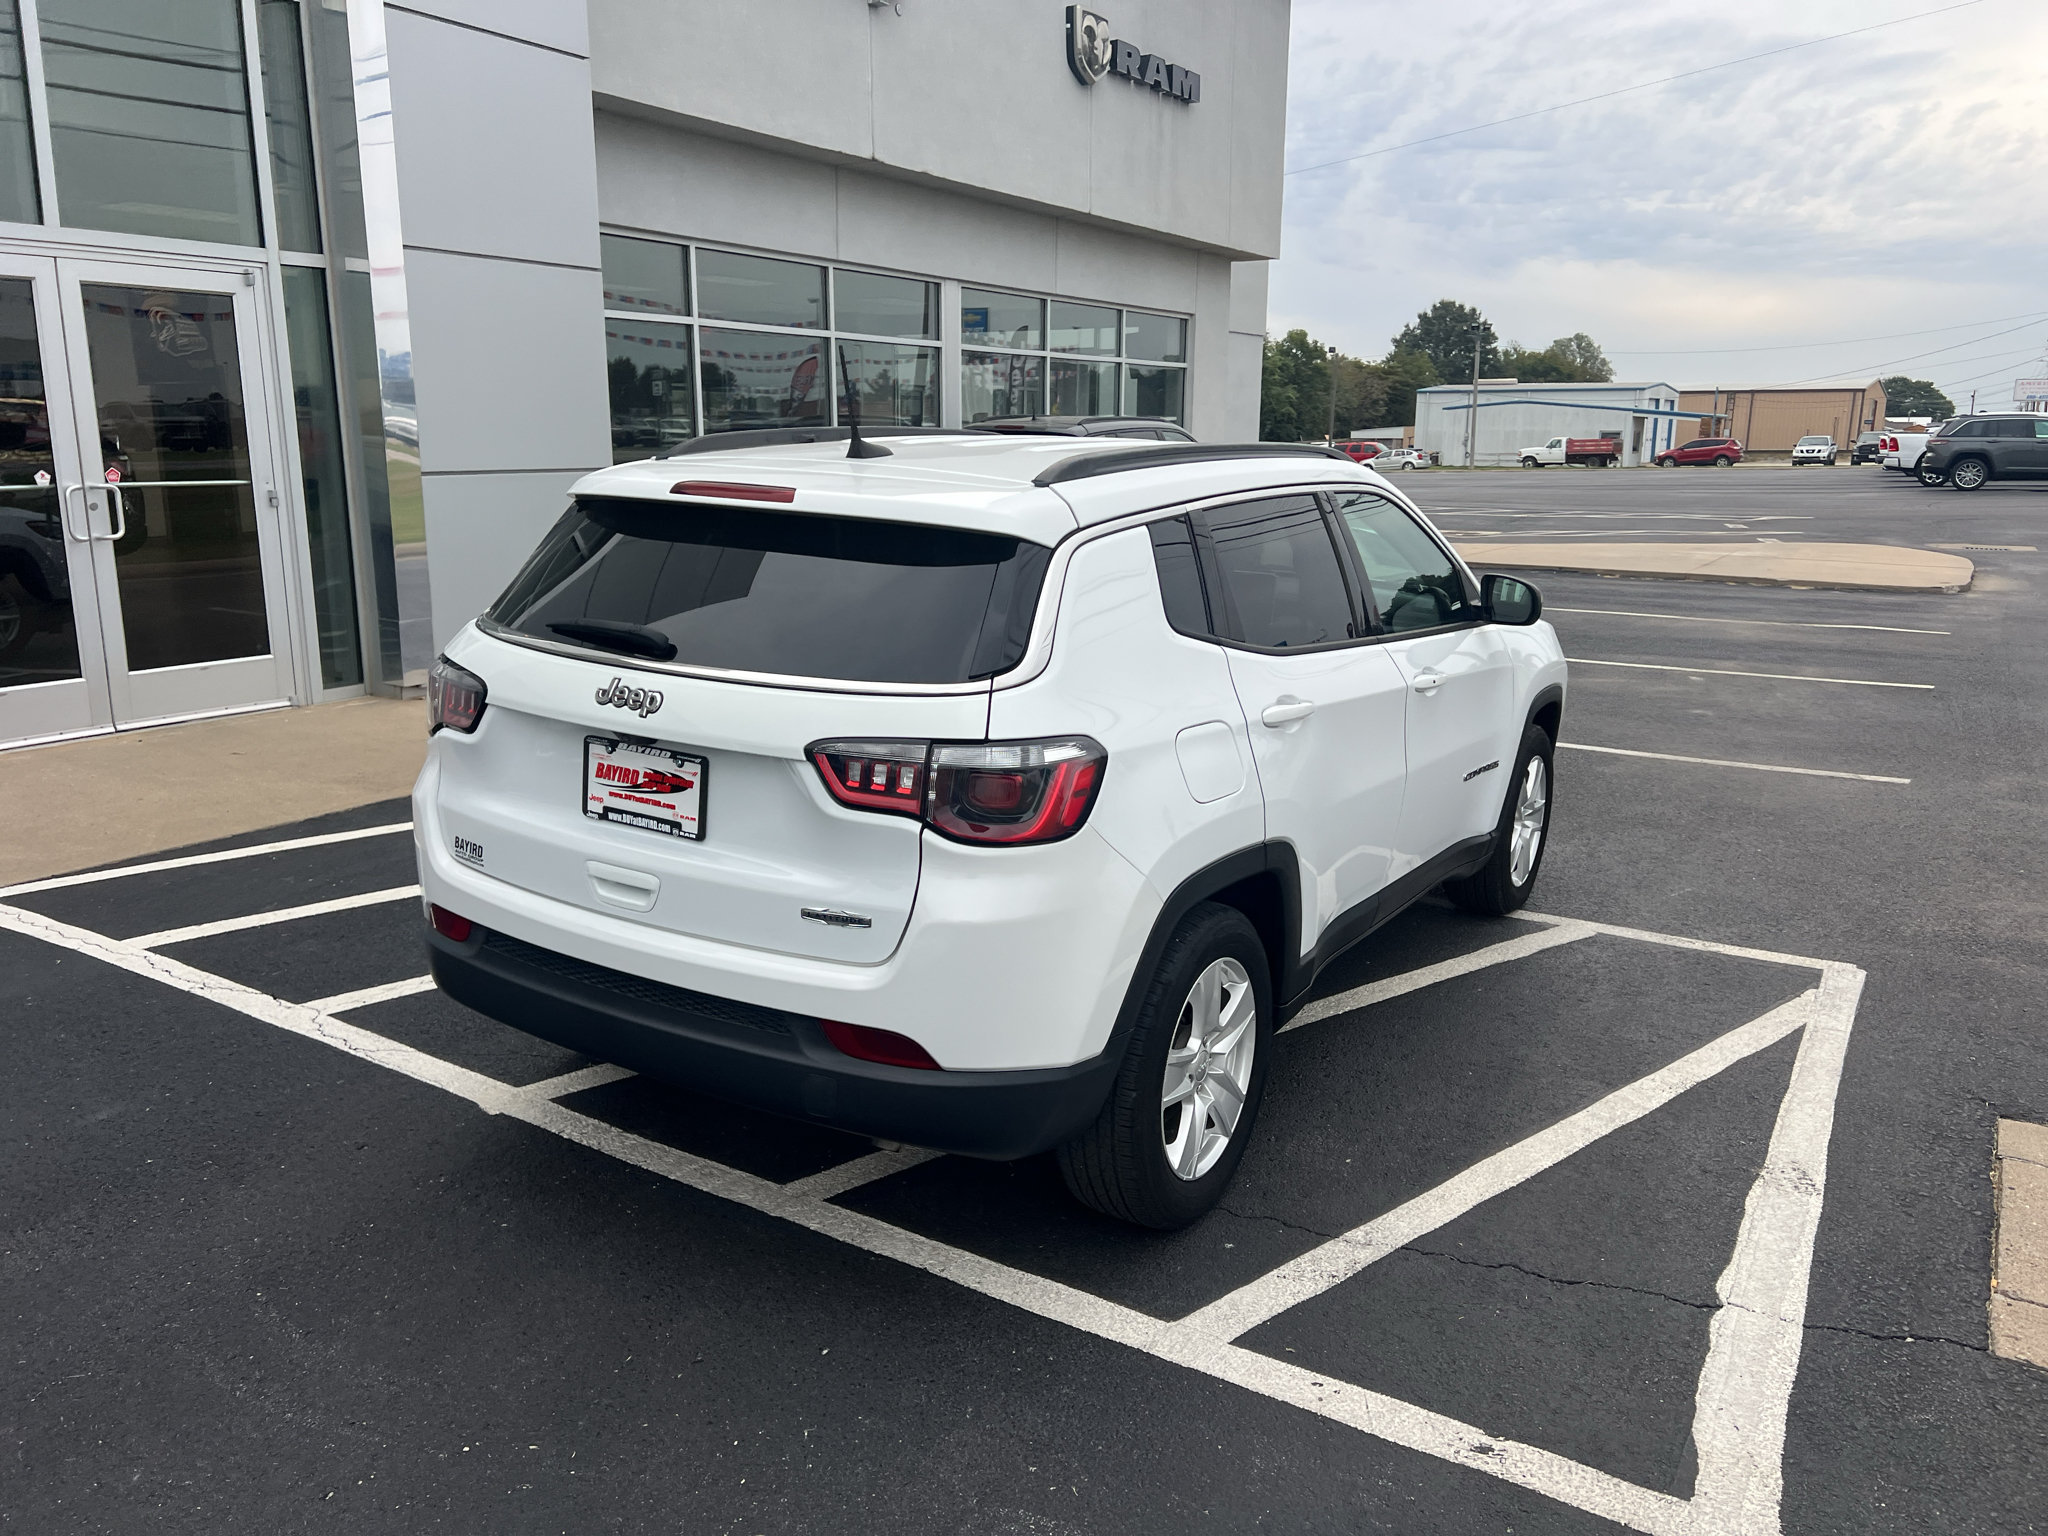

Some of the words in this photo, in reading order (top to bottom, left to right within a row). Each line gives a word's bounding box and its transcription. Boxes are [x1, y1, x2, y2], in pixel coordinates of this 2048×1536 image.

[1110, 39, 1200, 103] RAM
[595, 677, 664, 718] Jeep
[617, 742, 671, 758] BAYIRD
[595, 762, 640, 785] BAYIRD
[680, 814, 696, 822] RAM
[454, 835, 484, 858] BAYIRD
